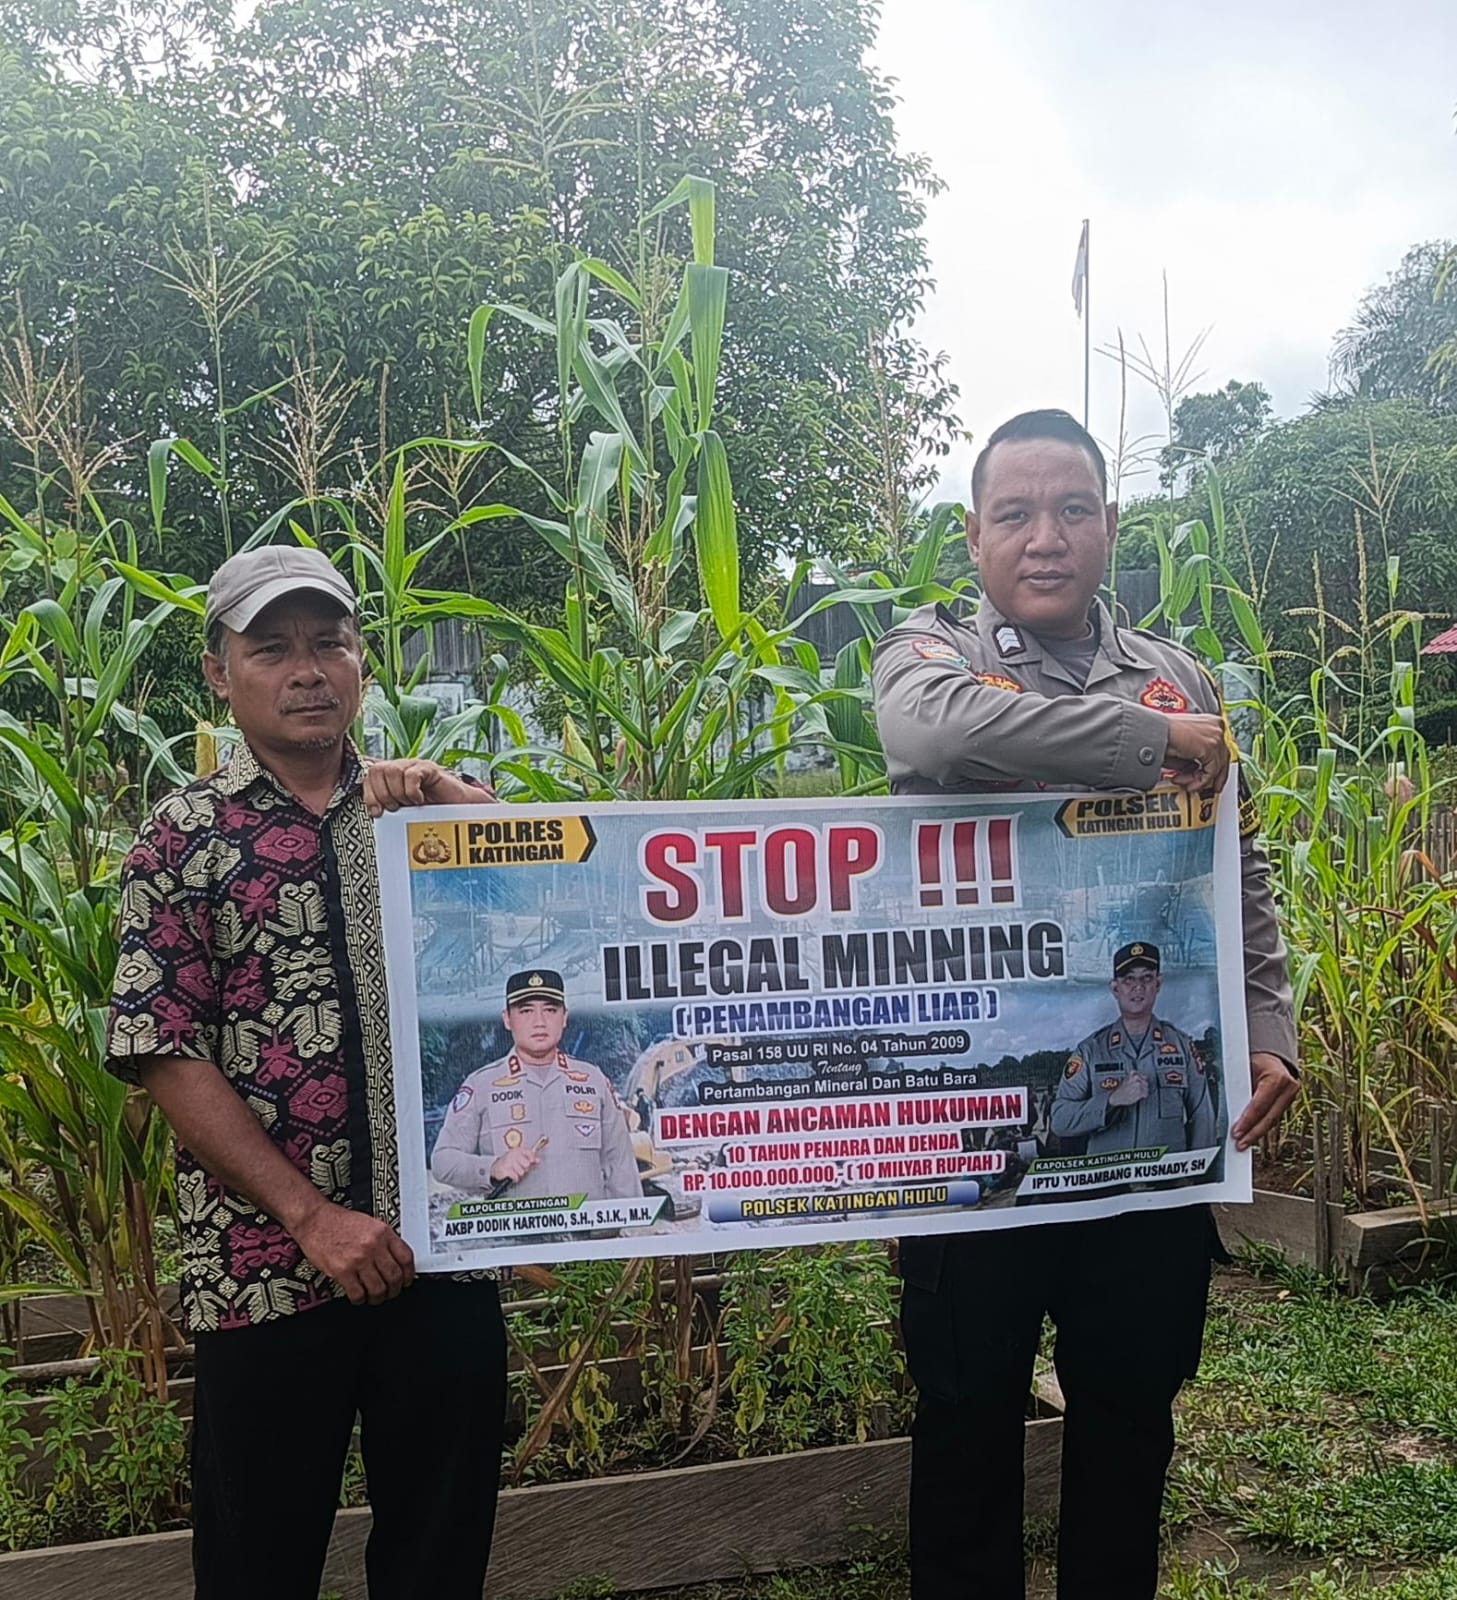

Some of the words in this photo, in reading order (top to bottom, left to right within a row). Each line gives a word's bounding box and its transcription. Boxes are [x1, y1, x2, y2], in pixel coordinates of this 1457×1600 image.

[1076, 791, 1180, 818] POLSEK
[468, 819, 563, 845] POLRES
[1076, 816, 1144, 834] KATINGAN
[1146, 813, 1181, 830] HULU
[469, 843, 564, 864] KATINGAN
[643, 825, 879, 922] STOP
[917, 817, 1016, 907] !!!
[602, 936, 809, 1002] ILLEGAL
[821, 921, 1066, 989] MINNING
[712, 1047, 753, 1063] Pasal
[757, 1045, 782, 1061] 158
[786, 1044, 809, 1060] UU
[812, 1042, 829, 1057] RI
[832, 1040, 857, 1056] No.
[860, 1039, 878, 1055] 04
[881, 1037, 927, 1053] Tahun
[930, 1034, 966, 1050] 2009
[816, 1059, 863, 1077] Tentang
[491, 1090, 524, 1103] DODIK
[565, 1085, 596, 1096] POLRI
[703, 1081, 811, 1100] Pertambangan
[814, 1077, 869, 1094] Mineral
[872, 1075, 901, 1091] Dan
[905, 1072, 940, 1089] Batu
[943, 1071, 977, 1086] Bara
[660, 1109, 761, 1140] DENGAN
[766, 1101, 892, 1133] ANCAMAN
[900, 1094, 1022, 1126] HUKUMAN
[727, 1146, 745, 1164] 10
[748, 1143, 801, 1162] TAHUN
[804, 1138, 870, 1159] PENJARA
[873, 1136, 905, 1155] DAN
[908, 1133, 960, 1153] DENDA
[1035, 1160, 1086, 1171] KAPOLSEK
[1087, 1154, 1132, 1167] KATINGAN
[1133, 1150, 1159, 1162] HULU
[683, 1173, 706, 1192] RP.
[878, 1157, 933, 1179] MILYAR
[1032, 1176, 1060, 1190] IPTU
[1063, 1167, 1132, 1187] YUBAMBANG
[1134, 1161, 1189, 1178] KUSNADY,
[1190, 1158, 1206, 1171] SH
[461, 1202, 514, 1215] KAPOLRES
[516, 1198, 569, 1211] KATINGAN
[742, 1198, 809, 1217] POLSEK
[812, 1191, 898, 1212] KATINGAN
[901, 1187, 947, 1204] HULU
[444, 1222, 474, 1237] AKBP
[476, 1217, 511, 1233] DODIK
[513, 1212, 568, 1231] HARTONO,
[570, 1210, 594, 1226] S.H.,
[628, 1207, 653, 1222] M.H.
